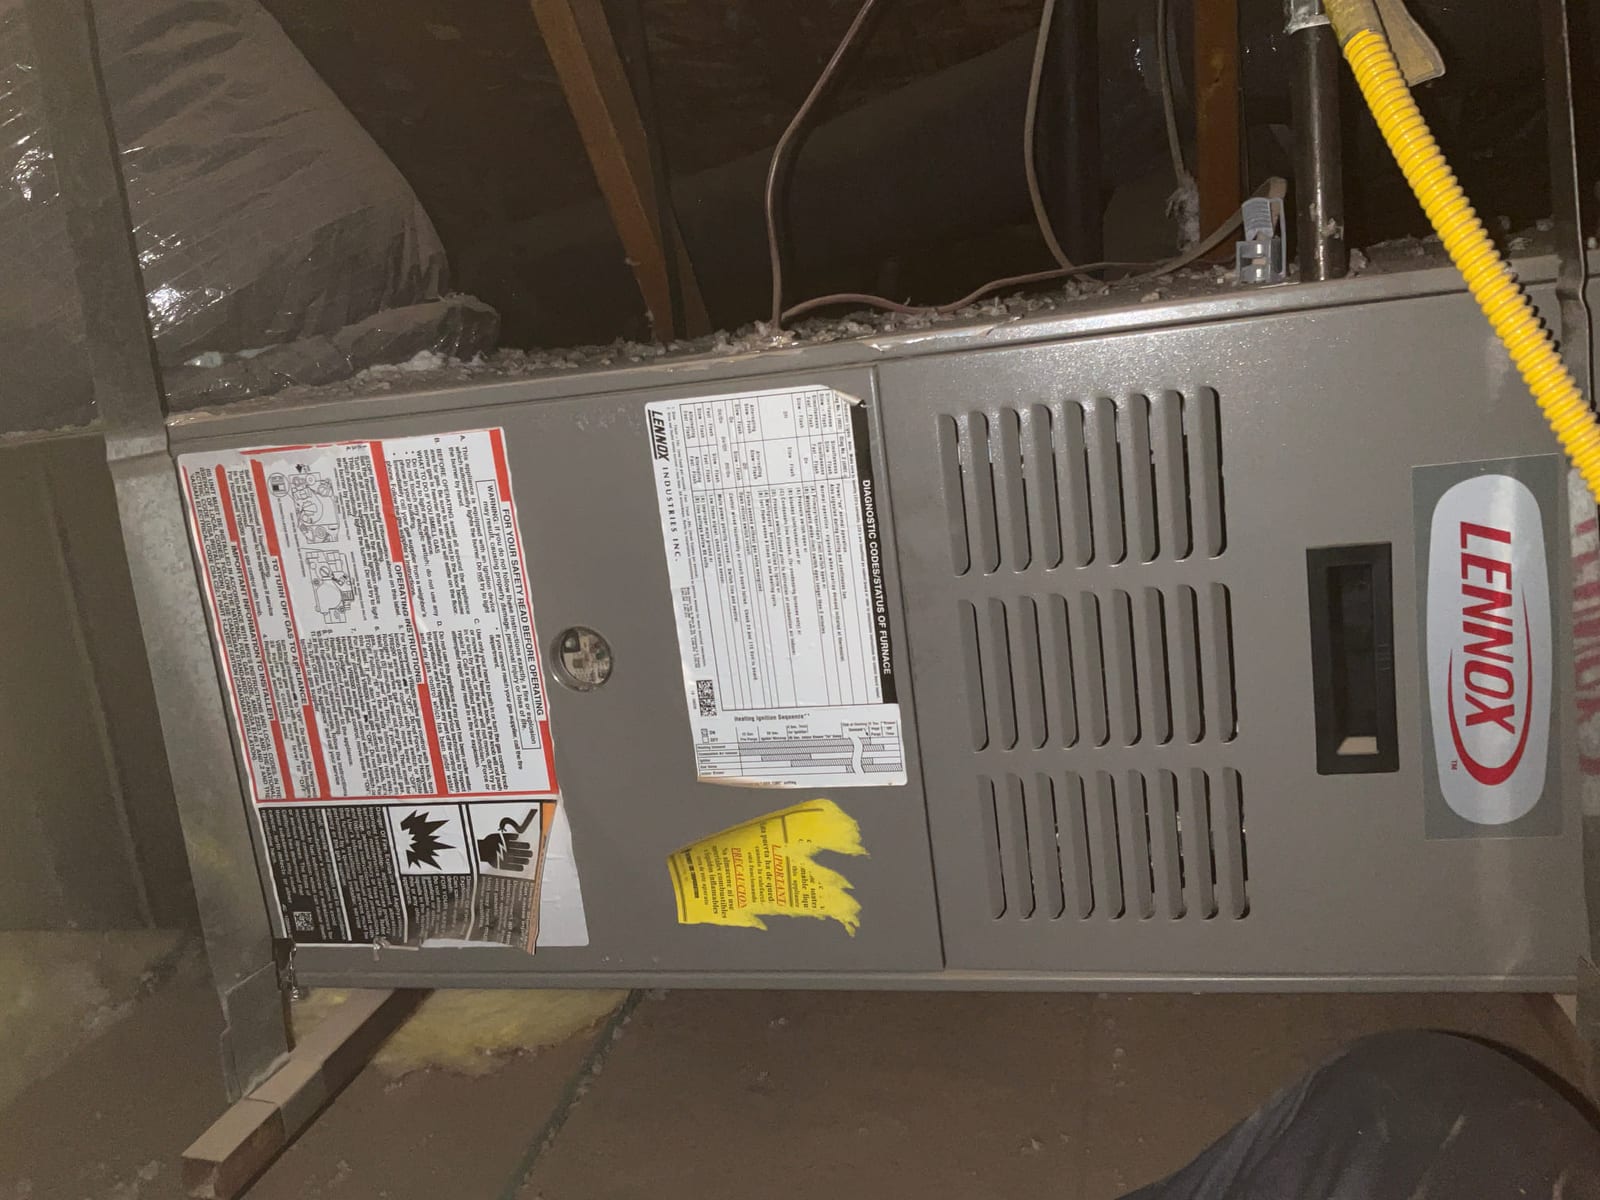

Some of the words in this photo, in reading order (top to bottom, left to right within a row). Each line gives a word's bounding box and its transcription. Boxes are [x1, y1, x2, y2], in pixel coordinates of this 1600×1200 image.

[416, 449, 424, 469] WHAT
[455, 446, 463, 465] which
[461, 446, 469, 460] This
[420, 471, 426, 480] TO
[450, 458, 459, 479] burner
[463, 463, 475, 495] appliance
[207, 478, 215, 494] UNIT
[422, 481, 428, 492] DO
[453, 480, 460, 488] by
[458, 466, 471, 508] automatically
[650, 410, 669, 461] LENNOX
[661, 466, 677, 532] INDUSTRIES
[671, 538, 682, 561] INC.
[211, 496, 220, 515] MUST
[411, 458, 417, 467] Do
[417, 497, 425, 512] light
[422, 525, 433, 555] appliance.
[456, 489, 464, 507] hand.
[481, 500, 489, 516] may
[487, 484, 499, 525] WARNING:
[862, 479, 875, 539] DIAGNOSTIC
[216, 517, 222, 527] BE
[428, 516, 436, 537] SMELL
[465, 509, 474, 526] lights
[471, 506, 482, 537] equipped
[502, 508, 512, 528] FOR
[484, 517, 495, 541] result,
[493, 532, 501, 546] you
[218, 529, 231, 566] INSTALLED
[471, 538, 480, 560] burner.
[497, 547, 504, 557] do
[505, 530, 517, 557] YOUR
[271, 559, 279, 571] TO
[475, 561, 482, 570] Do
[480, 554, 485, 563] an
[488, 541, 500, 570] causing
[499, 558, 507, 570] not
[230, 545, 246, 595] IMPORTANT
[481, 565, 491, 590] ignition
[510, 559, 523, 595] SAFETY
[868, 541, 884, 612] CODES/STATUS
[275, 574, 284, 598] TURN
[493, 571, 505, 601] property
[501, 571, 511, 593] follow
[229, 576, 243, 623] ACCORDANCE
[280, 600, 289, 618] OFF
[481, 599, 489, 613] light
[487, 591, 495, 612] device
[505, 594, 514, 613] these
[517, 597, 528, 623] READ
[242, 598, 260, 658] INFORMATION
[393, 564, 409, 616] OPERATING
[404, 618, 421, 683] INSTRUCTIONS
[499, 602, 511, 632] damage,
[877, 615, 886, 628] OF
[1460, 521, 1516, 734] LENNOX
[284, 620, 293, 638] GAS
[509, 614, 521, 656] instructions
[289, 642, 296, 653] TO
[504, 633, 516, 663] personal
[521, 625, 534, 661] BEFORE
[879, 630, 891, 674] FURNACE
[255, 659, 263, 671] TO
[509, 664, 519, 684] injury
[515, 657, 526, 683] exactly,
[292, 655, 307, 703] APPLIANCE
[528, 664, 543, 715] OPERATING
[258, 673, 273, 719] INSTALLER
[516, 694, 524, 708] loss
[518, 709, 525, 717] of
[524, 711, 536, 744] explosion
[766, 872, 772, 880] de
[718, 873, 727, 918] combustibles
